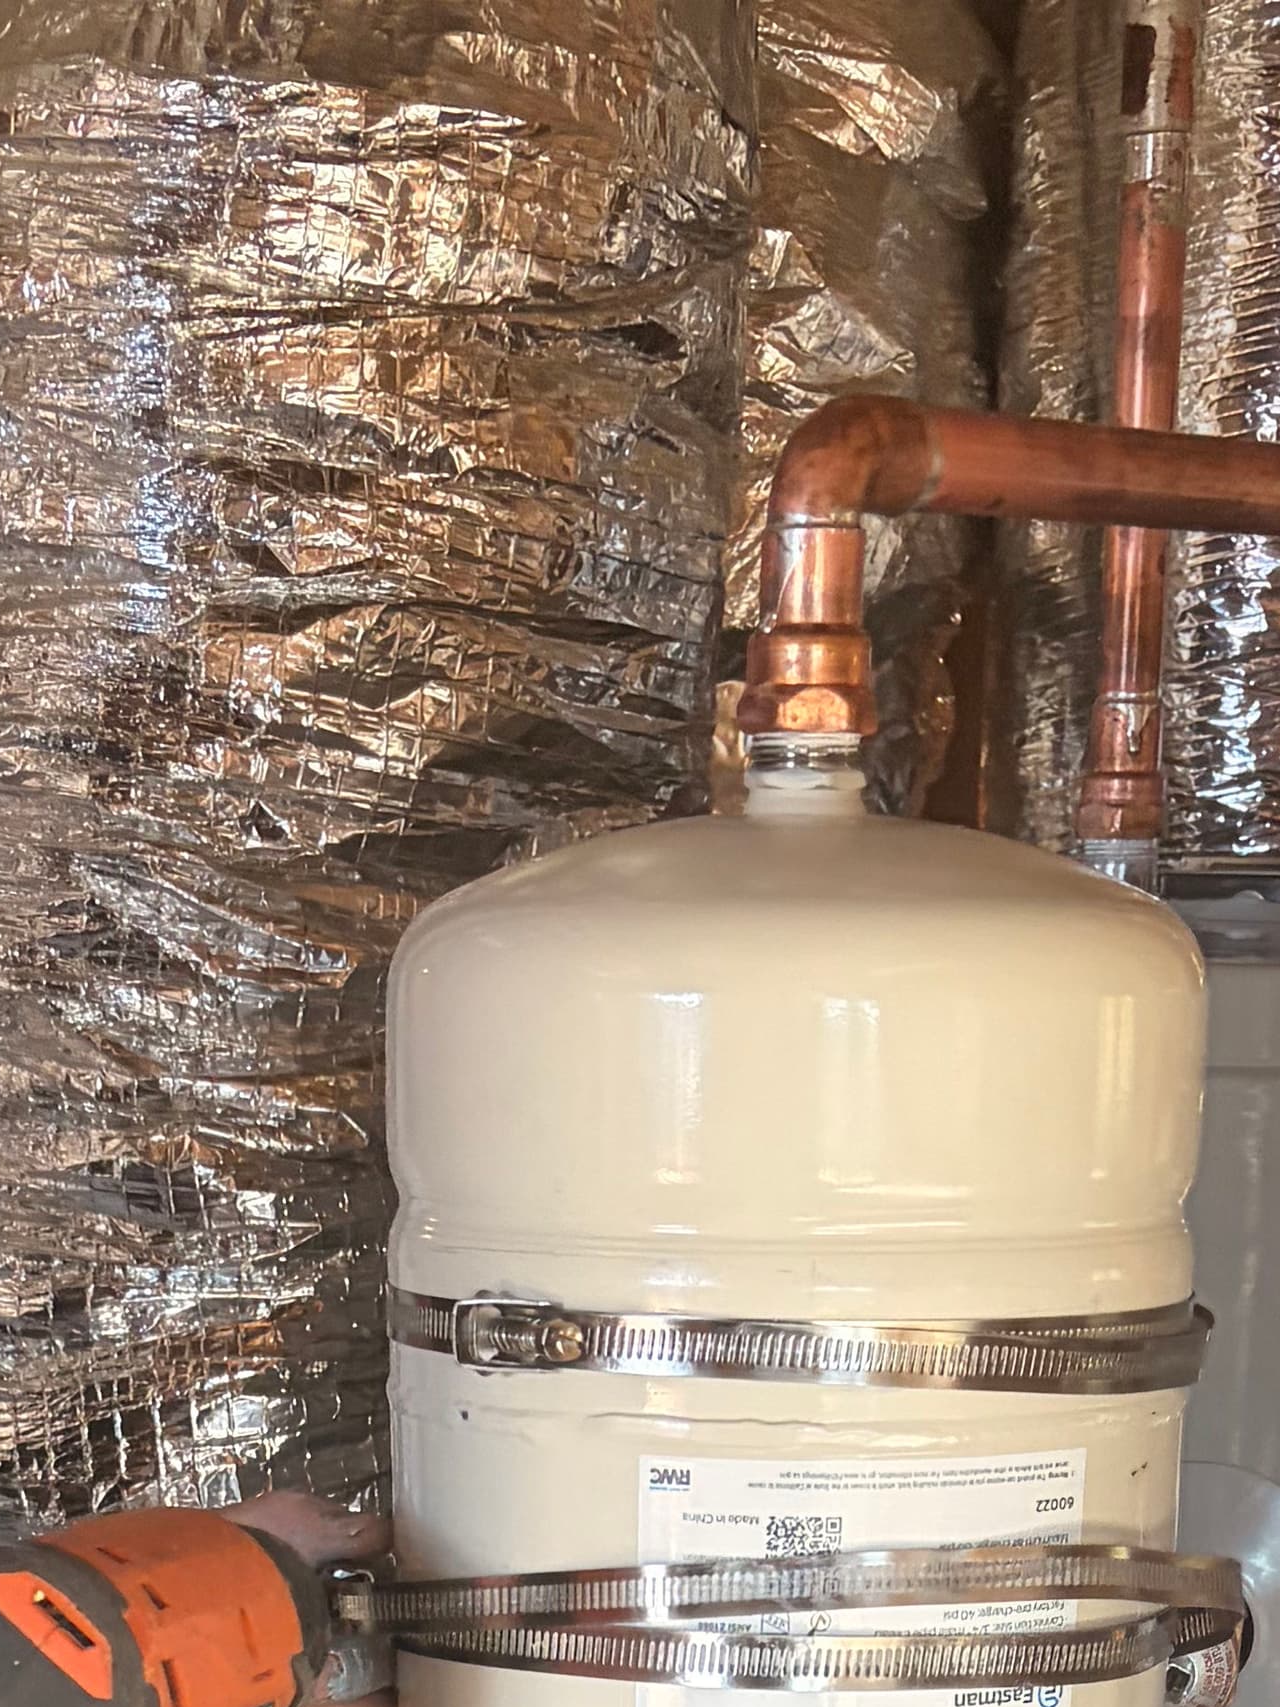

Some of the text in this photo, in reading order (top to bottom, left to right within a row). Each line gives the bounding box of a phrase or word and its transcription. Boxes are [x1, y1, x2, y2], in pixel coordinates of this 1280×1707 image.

[650, 1467, 691, 1486] RWC
[1035, 1496, 1075, 1513] 60022
[682, 1512, 760, 1526] Made in China
[954, 1686, 1034, 1707] Eastman
